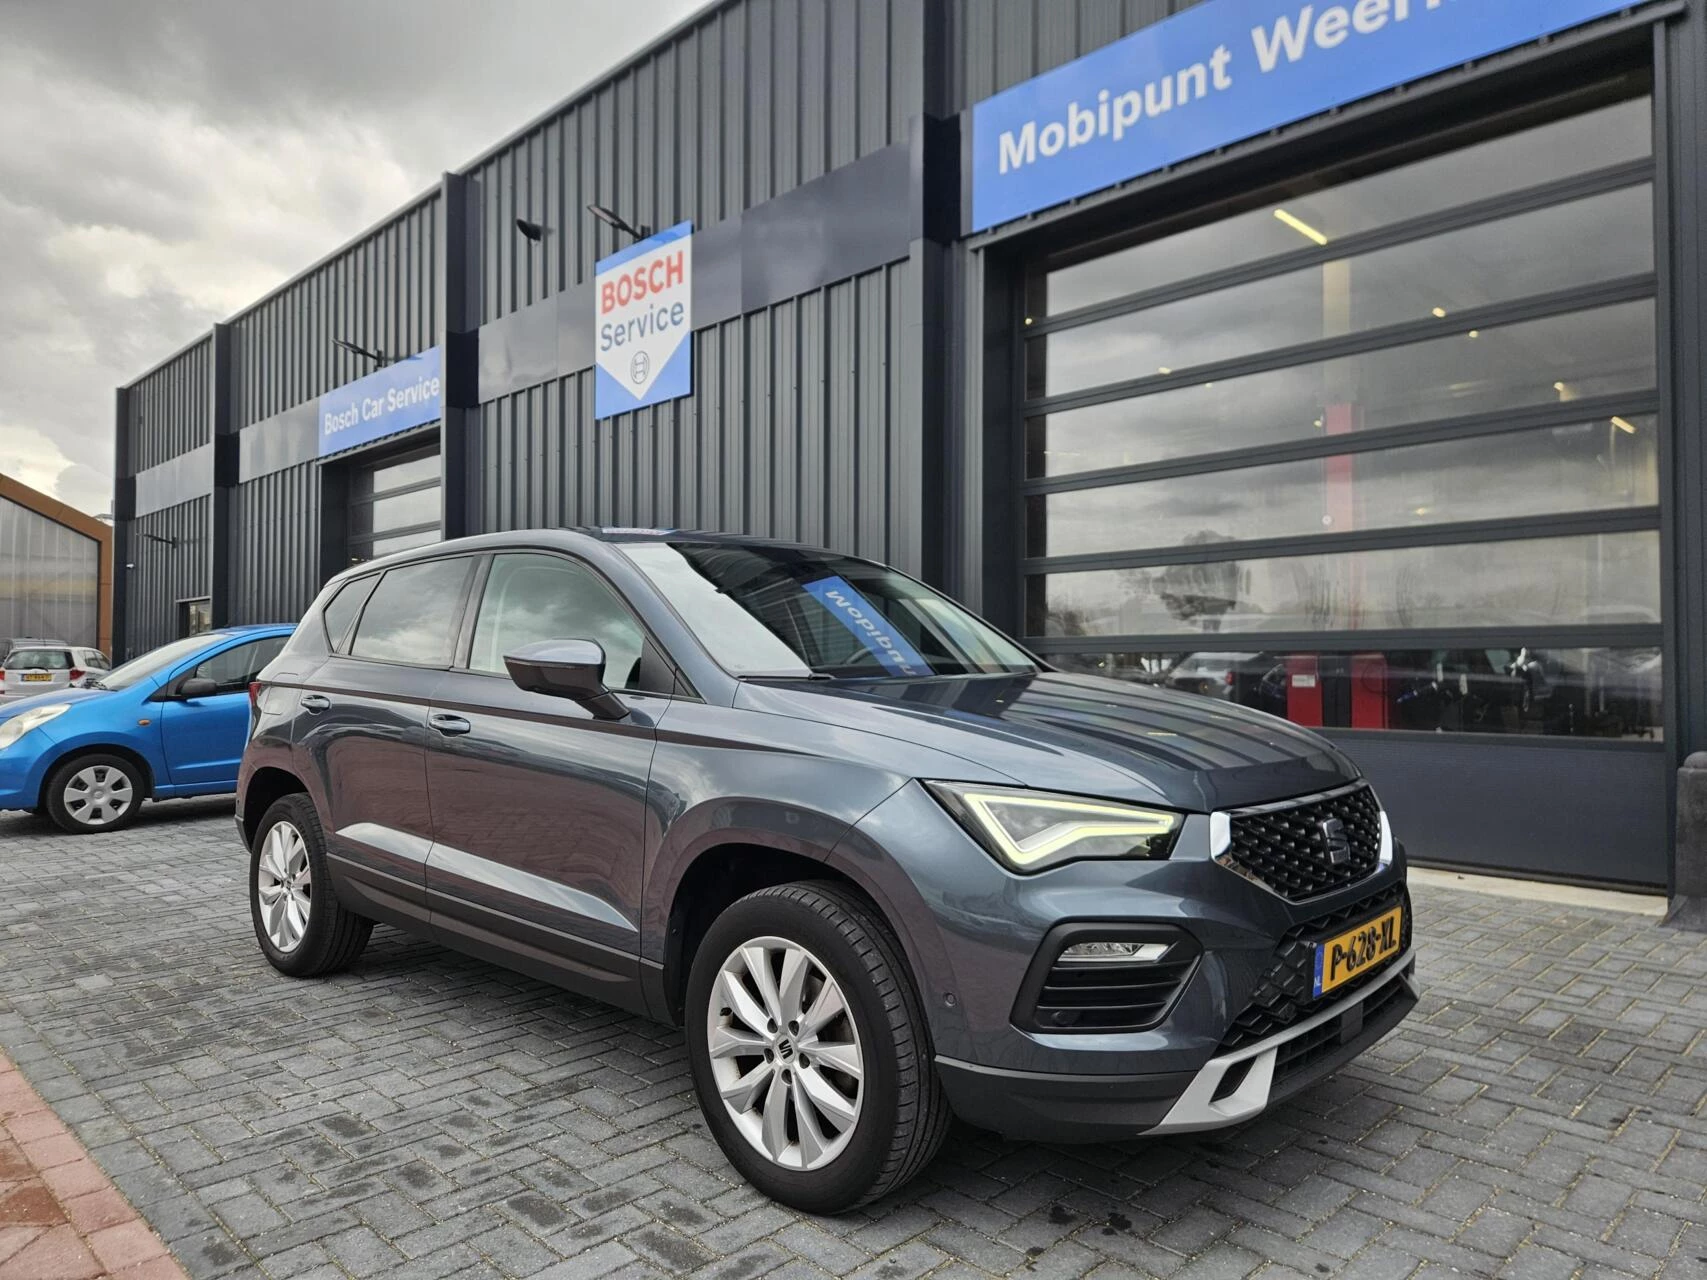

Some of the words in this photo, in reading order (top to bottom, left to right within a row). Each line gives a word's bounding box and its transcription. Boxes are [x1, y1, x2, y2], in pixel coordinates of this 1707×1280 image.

[999, 44, 1232, 175] Mobipunt
[602, 251, 684, 315] BOSCH
[600, 301, 685, 352] Service
[324, 402, 359, 435] Bosch
[362, 398, 384, 421] Car
[387, 376, 440, 412] Service
[1330, 916, 1396, 981] P-628-XL
